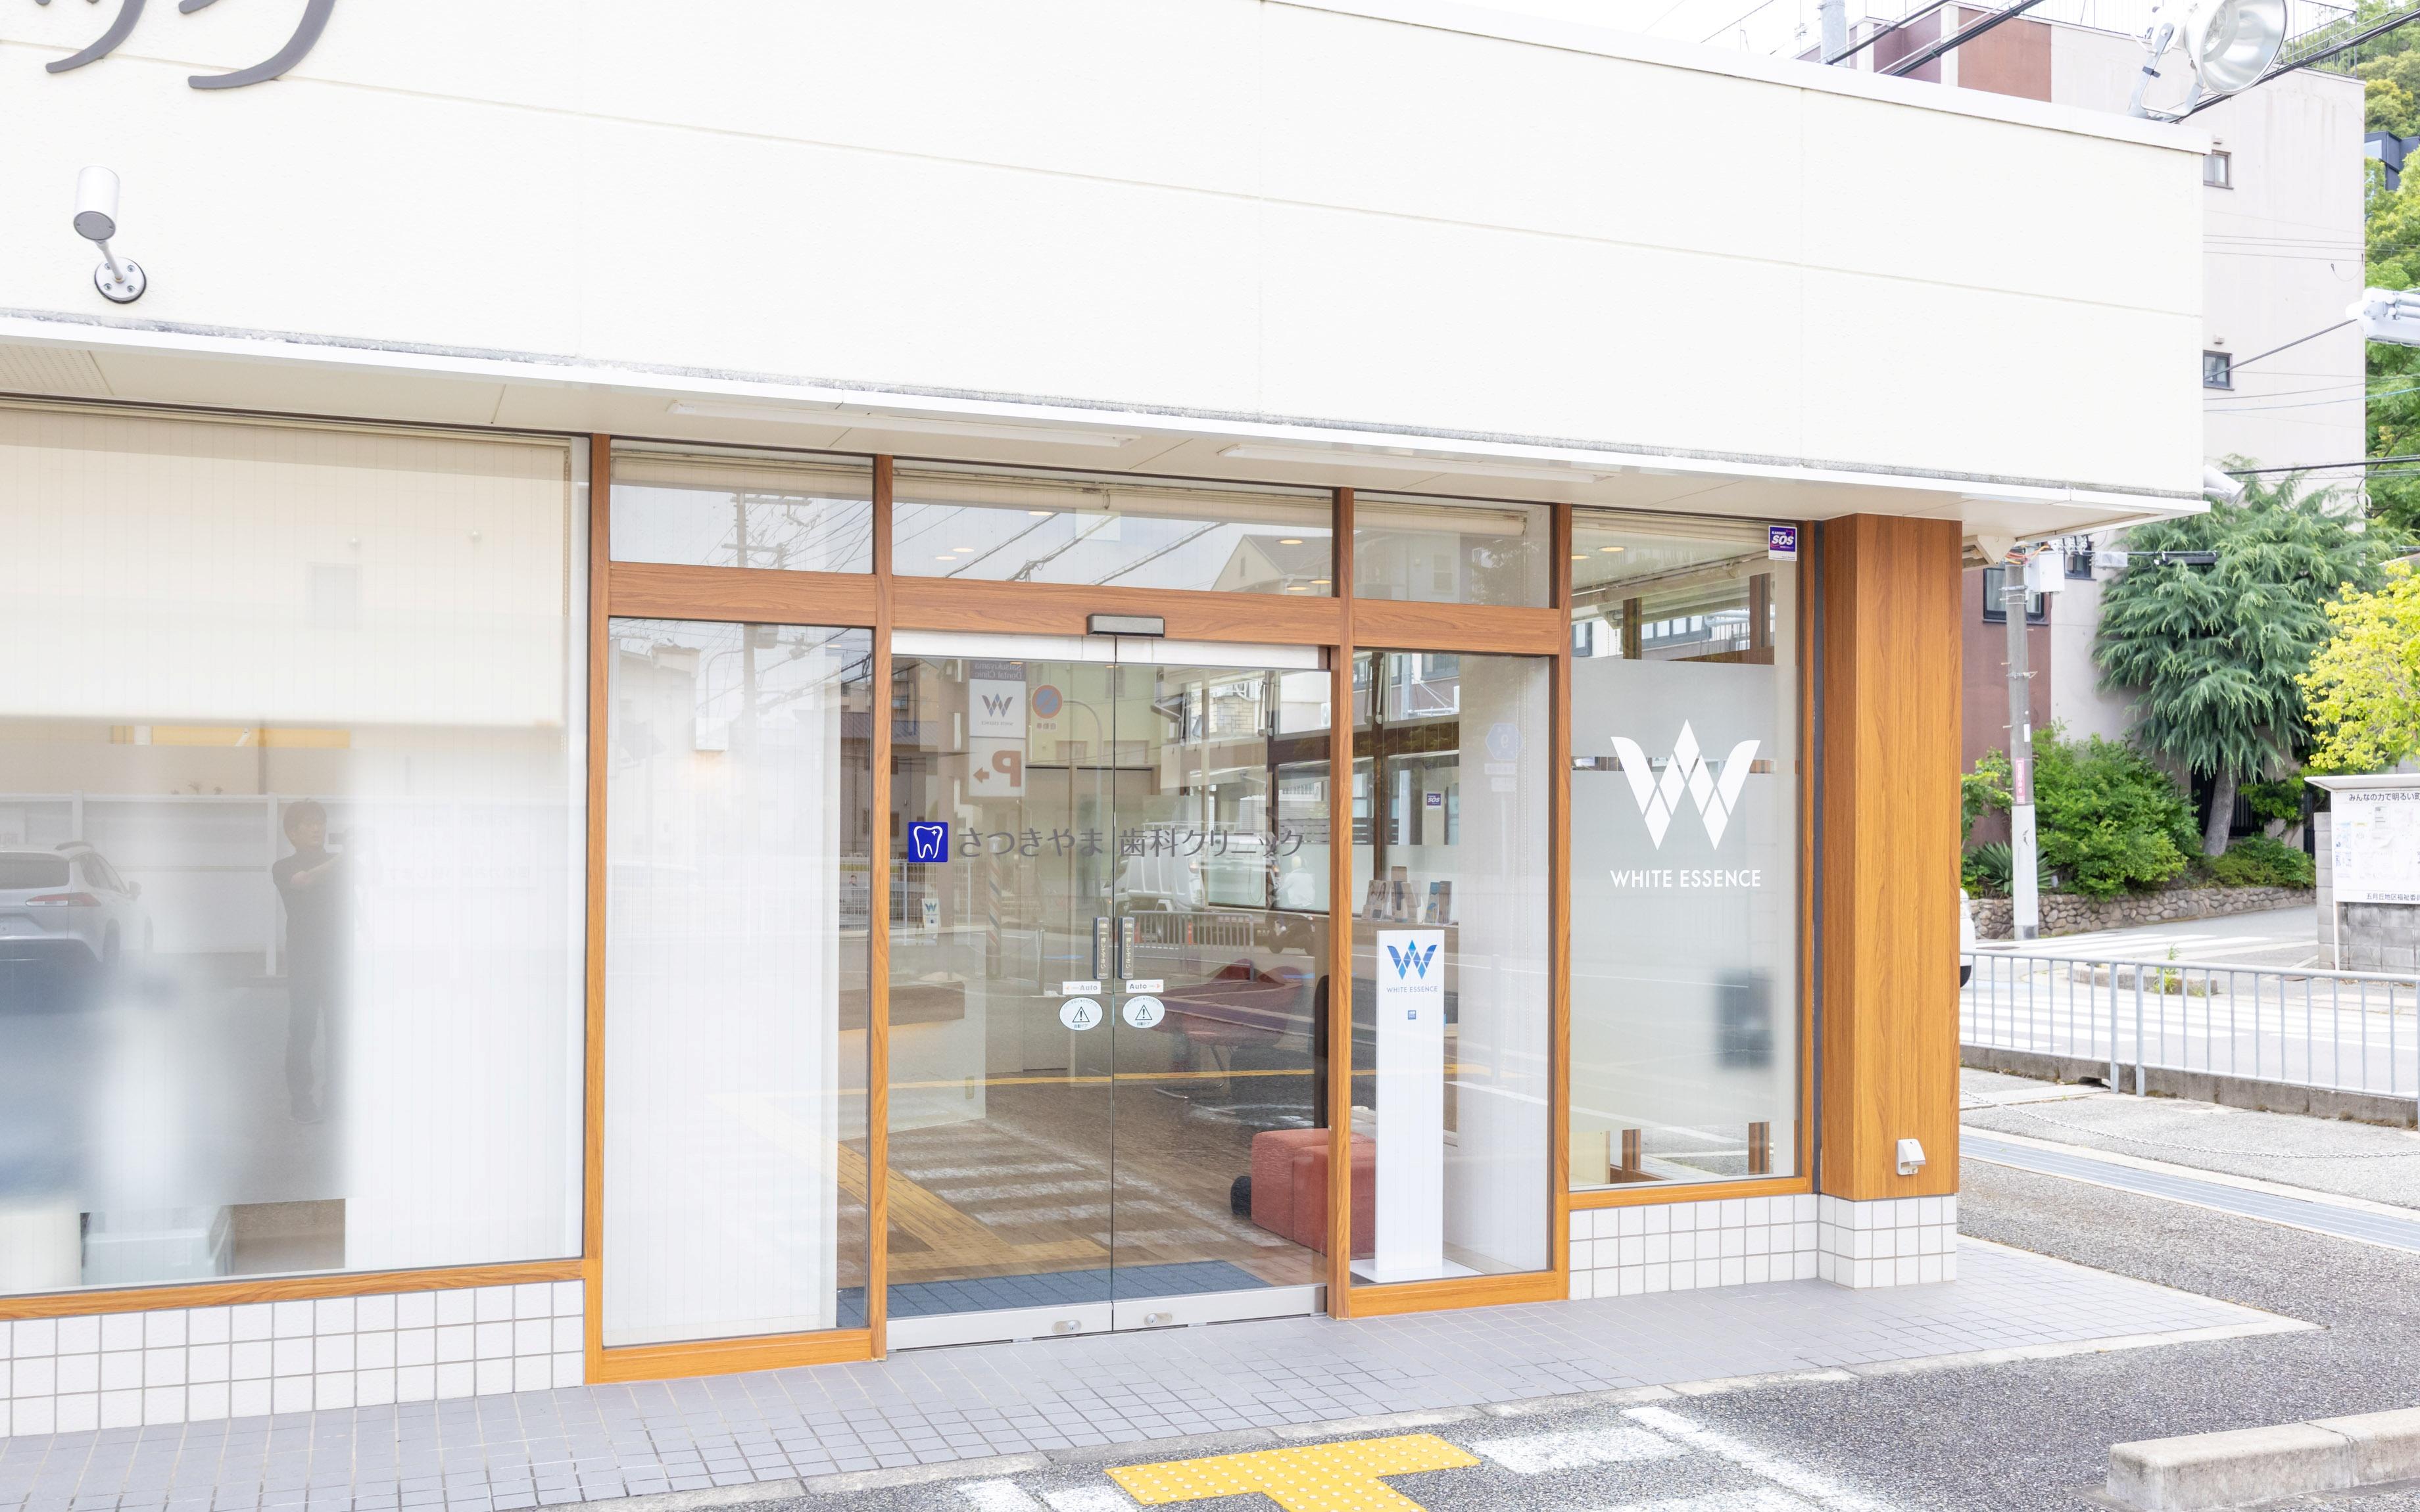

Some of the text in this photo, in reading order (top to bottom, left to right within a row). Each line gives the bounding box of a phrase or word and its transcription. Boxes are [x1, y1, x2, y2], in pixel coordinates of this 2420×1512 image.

[1772, 534, 1794, 545] SOS
[958, 827, 1304, 858] さつきやま 歯科クリニック
[1610, 869, 1761, 888] WHITE ESSENCE
